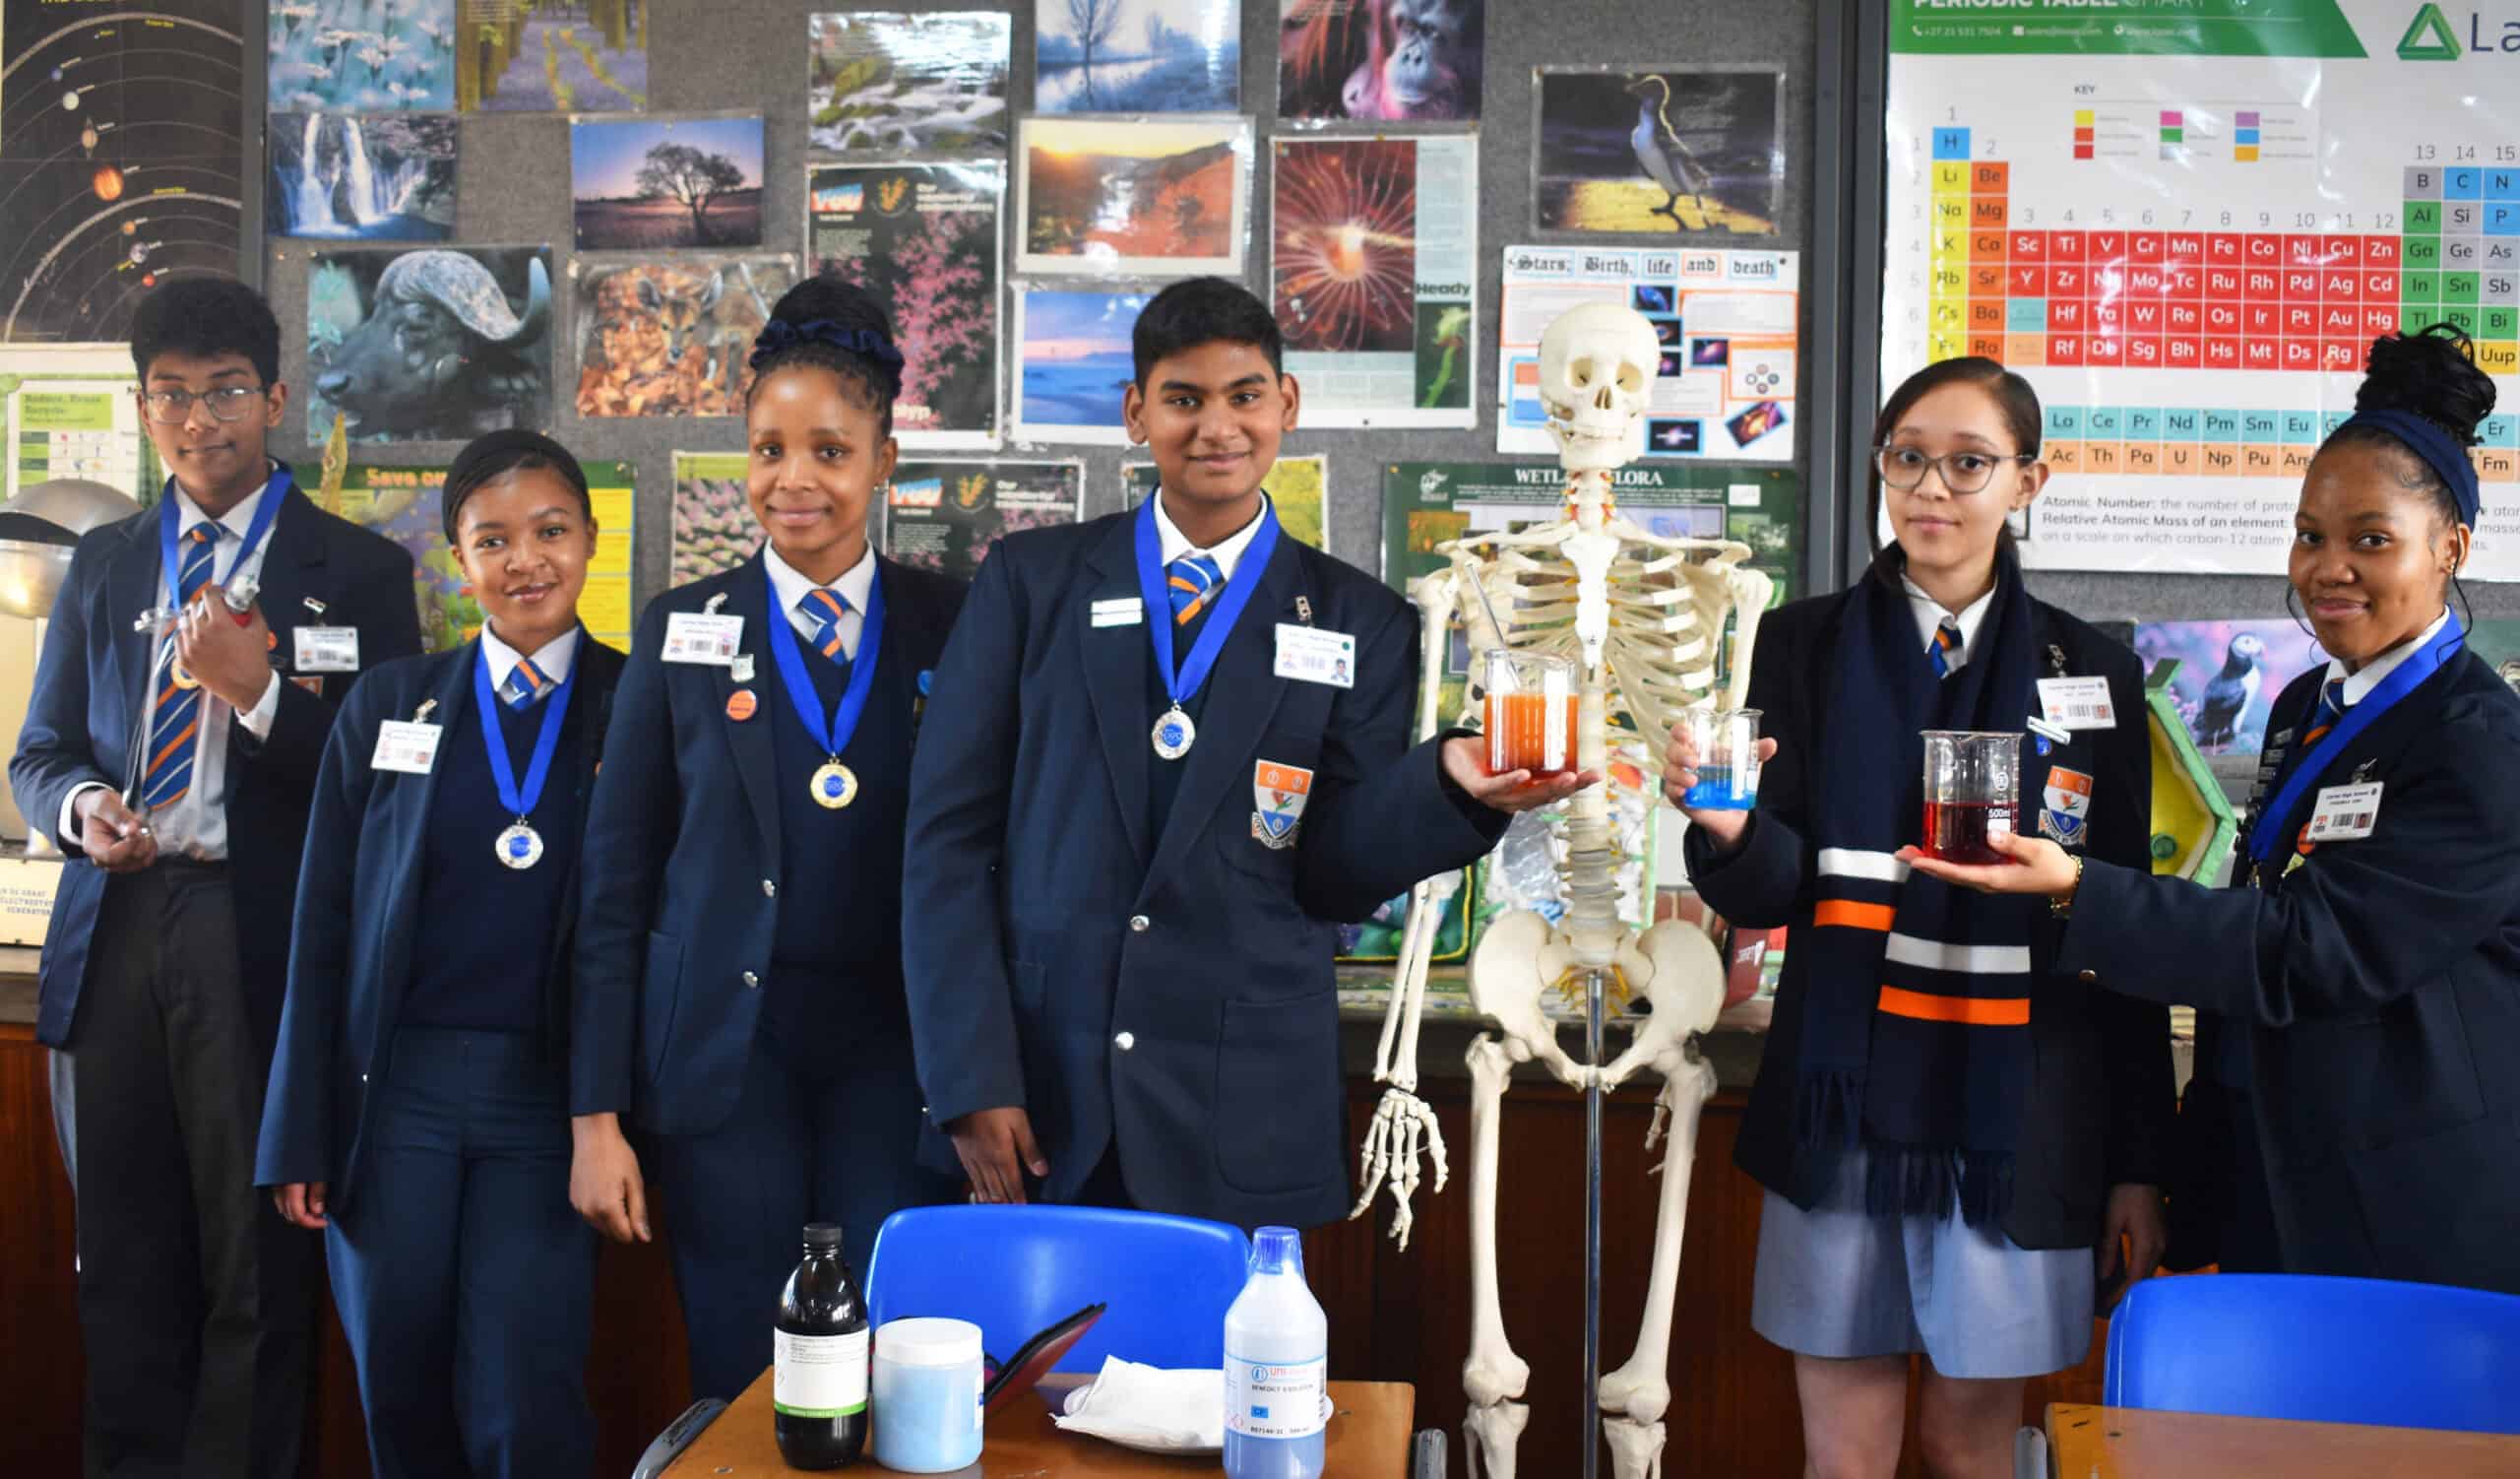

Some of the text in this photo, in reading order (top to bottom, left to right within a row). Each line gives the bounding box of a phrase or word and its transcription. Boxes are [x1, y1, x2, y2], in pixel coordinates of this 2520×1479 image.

[2074, 85, 2095, 95] KEY
[1949, 106, 1956, 121] 1
[1945, 134, 1958, 150] H
[1986, 139, 1996, 156] 2
[2418, 145, 2515, 161] 13 14 15
[1943, 168, 2508, 189] Li Be B C N
[1939, 203, 2507, 224] Na Mg Al Si P
[2024, 208, 2034, 224] 3
[2063, 209, 2074, 222] 4
[2103, 208, 2113, 223] 5
[2142, 210, 2153, 225] 6
[2181, 210, 2192, 225] 7
[2221, 211, 2231, 226] 8
[2260, 213, 2270, 226] 9
[2296, 213, 2315, 228] 10
[2376, 213, 2394, 228] 12
[1944, 237, 1953, 250] K
[1977, 236, 2000, 252] Ca
[2018, 236, 2038, 252] Sc
[2058, 236, 2075, 252] Ti
[2101, 237, 2113, 252] V
[2136, 237, 2157, 253] Cr
[2173, 238, 2198, 253] Mn
[2215, 238, 2234, 254] Fe
[2251, 239, 2274, 256] Co
[2294, 241, 2310, 255] Ni
[2331, 241, 2353, 256] Cu
[2370, 241, 2392, 257] Zn
[2410, 242, 2433, 258] Ga
[2450, 243, 2473, 258] Ge
[2488, 244, 2512, 259] As
[1645, 258, 1671, 273] life
[1687, 258, 1715, 271] and
[1734, 260, 1775, 277] death
[1416, 282, 1472, 297] Heady
[1979, 271, 1995, 286] Sr
[2021, 271, 2033, 285] Y
[2057, 271, 2076, 287] Zr
[2130, 273, 2158, 289] Mo
[2174, 274, 2194, 288] Tc
[2212, 274, 2235, 289] Ru
[2250, 275, 2274, 290] Rh
[2291, 276, 2315, 290] Pd
[2328, 276, 2354, 294] Ag
[2369, 276, 2392, 291] Cd
[2413, 278, 2427, 291] In
[2449, 278, 2471, 291] Sn
[2488, 278, 2511, 293] Sb
[1976, 305, 2000, 320] Ba
[2055, 305, 2077, 321] Hf
[2135, 307, 2155, 322] W
[2173, 307, 2195, 323] Re
[2211, 307, 2234, 323] Os
[2255, 309, 2268, 325] Ir
[2292, 309, 2310, 325] Pt
[2328, 310, 2353, 325] Au
[2367, 311, 2392, 330] Hg
[2490, 313, 2507, 328] Bi
[1976, 341, 1997, 353] Ra
[2055, 340, 2075, 354] Rf
[2133, 341, 2155, 360] Sg
[2172, 342, 2194, 356] Bh
[2211, 343, 2234, 358] Hs
[2250, 344, 2271, 358] Mt
[2289, 344, 2311, 360] Ds
[2328, 345, 2351, 361] Rg
[2482, 347, 2515, 365] Uup
[2052, 414, 2504, 435] La Ce Pr Nd Pm Sm Eu Er
[2050, 449, 2073, 463] Ac
[2092, 449, 2112, 463] Th
[2131, 449, 2153, 464] Pa
[2174, 449, 2186, 465] U
[2208, 451, 2232, 469] Np
[2248, 451, 2270, 465] Pu
[2484, 457, 2508, 471] Fm
[366, 468, 417, 487] Save
[1515, 468, 1664, 485] WETL LORA
[2262, 501, 2297, 513] proto
